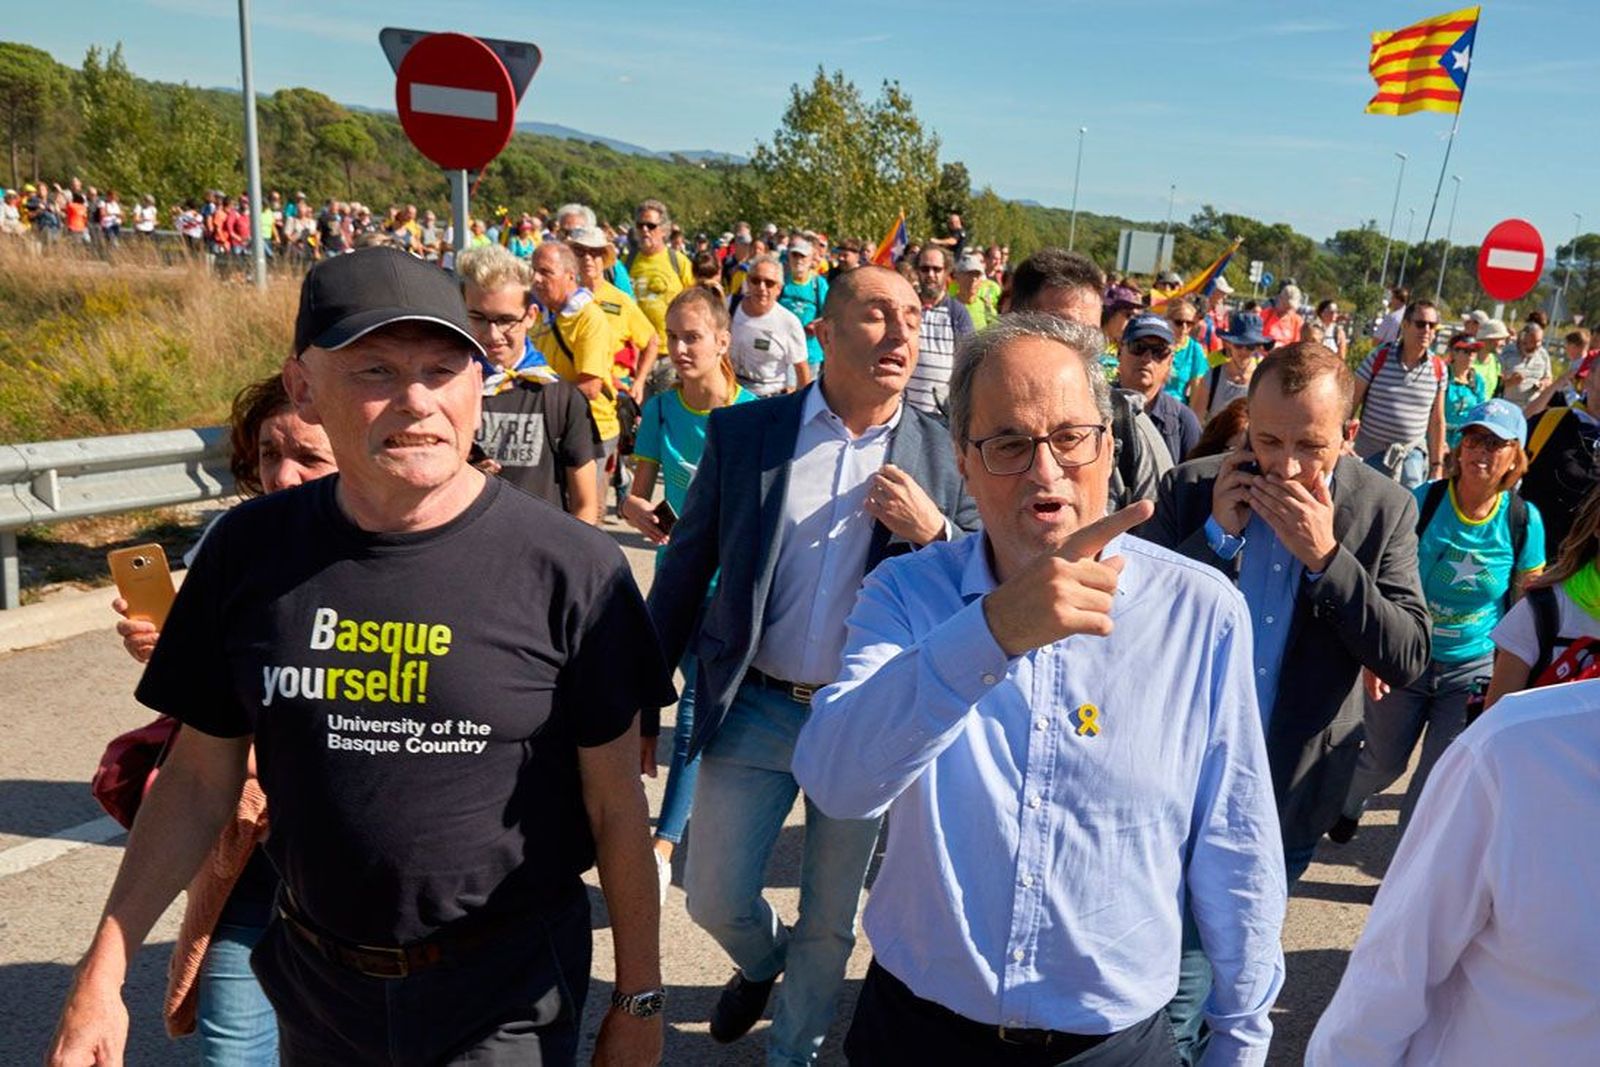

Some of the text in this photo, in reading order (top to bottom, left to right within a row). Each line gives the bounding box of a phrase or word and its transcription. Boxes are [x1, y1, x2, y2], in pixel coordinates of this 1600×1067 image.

[309, 607, 453, 657] Basque
[261, 657, 430, 707] yourself!
[327, 714, 492, 737] University of the
[327, 733, 489, 756] Basque Country
